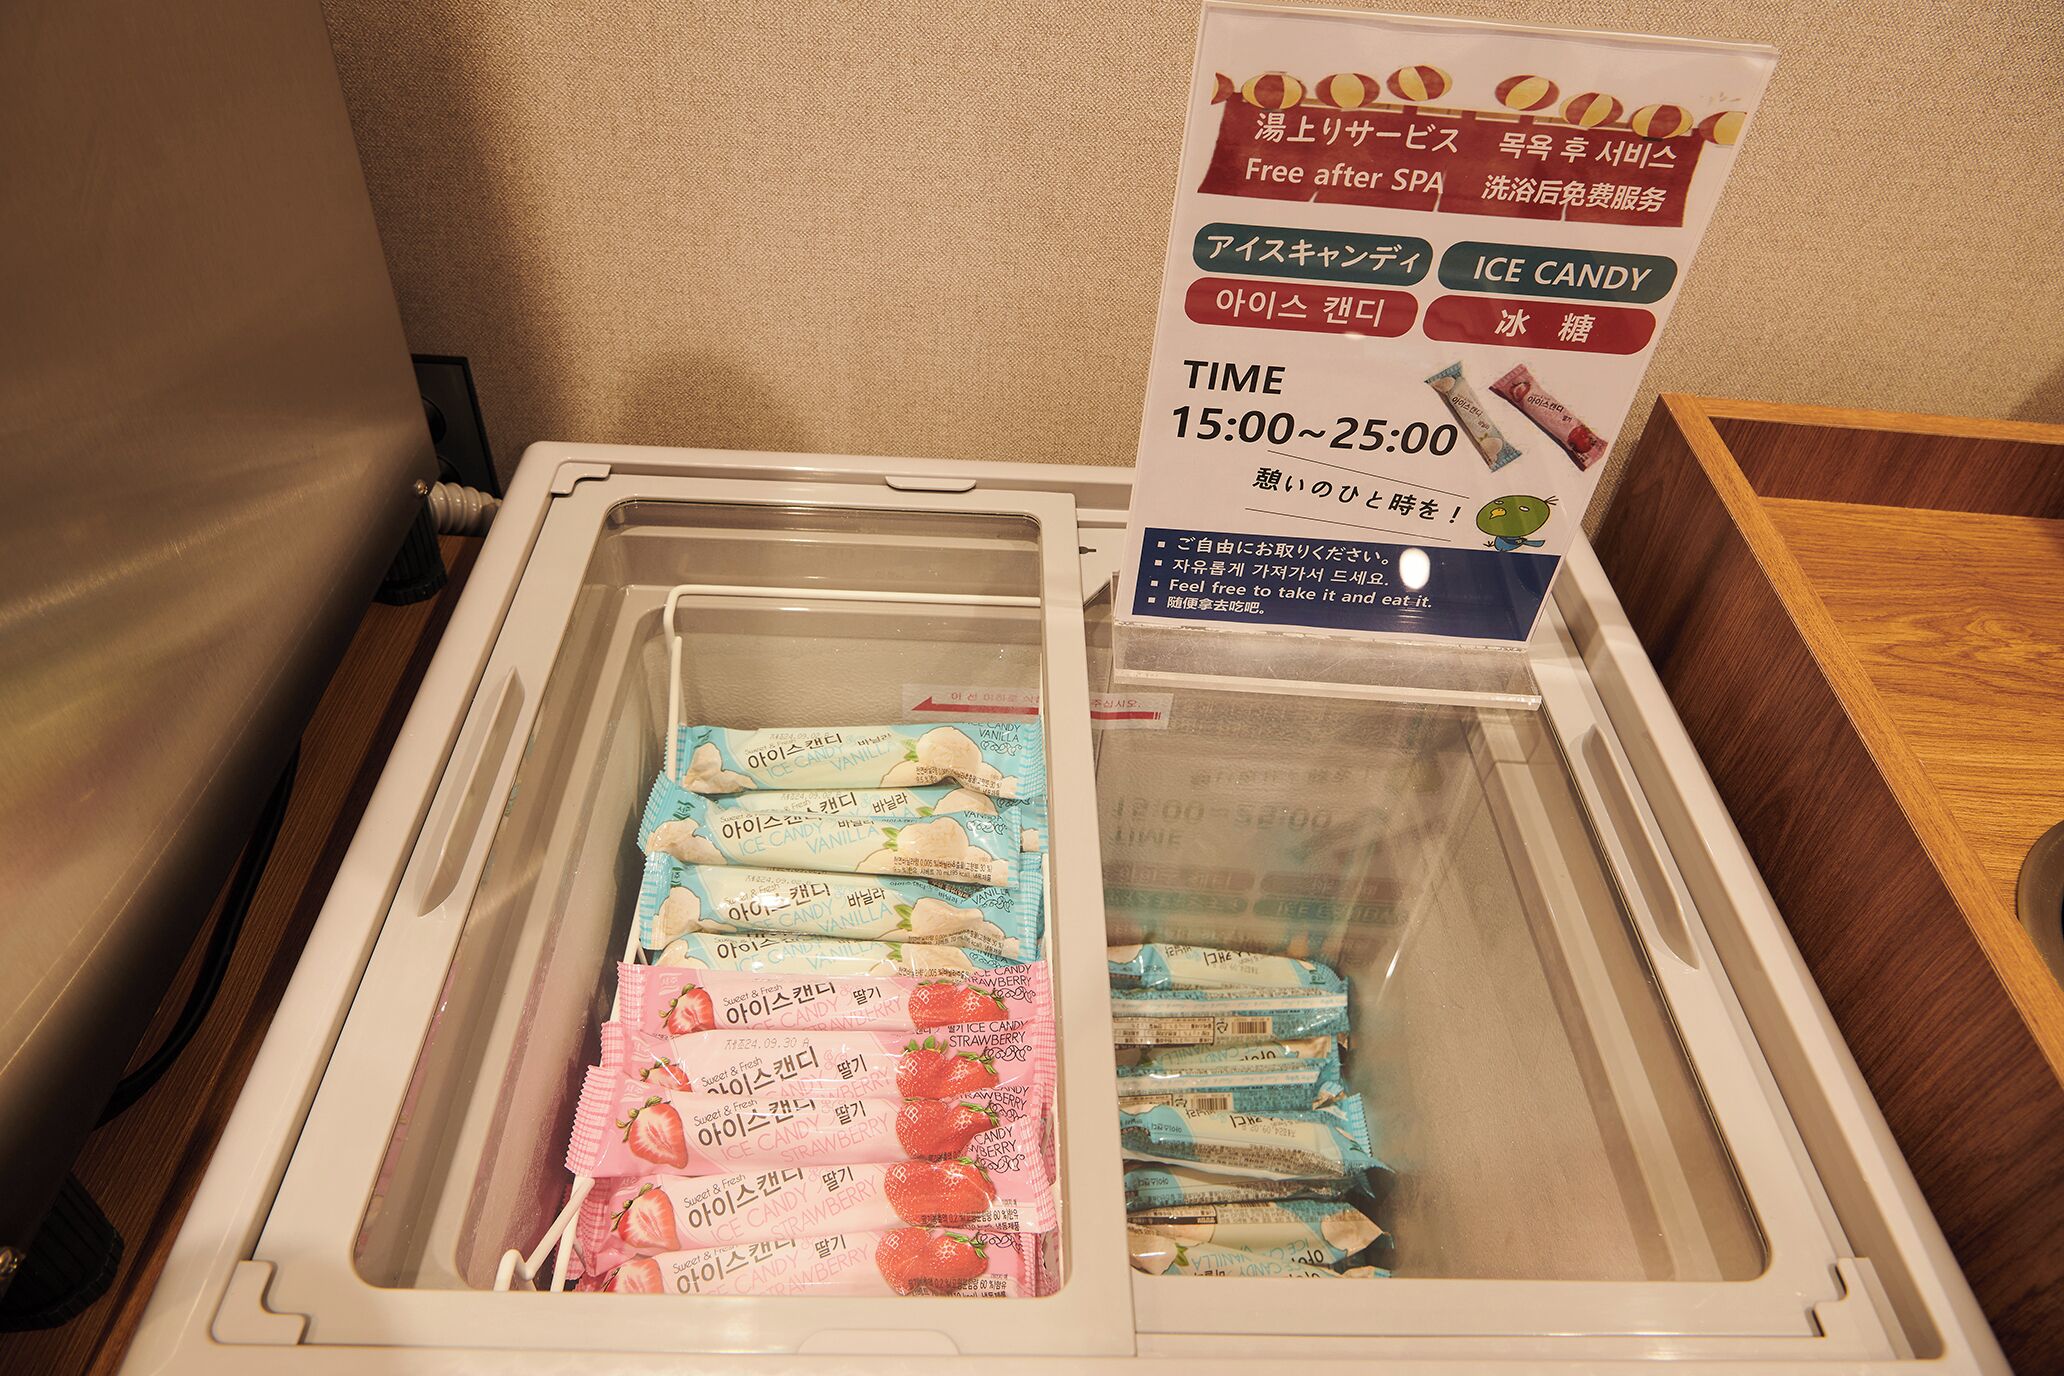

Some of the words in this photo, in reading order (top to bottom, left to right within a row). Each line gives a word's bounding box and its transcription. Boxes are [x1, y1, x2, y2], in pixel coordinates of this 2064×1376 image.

[1254, 112, 1459, 153] 湯上りサービス
[1499, 132, 1553, 161] 목욕
[1560, 137, 1589, 163] 후
[1595, 140, 1677, 169] 서비스
[1245, 157, 1305, 183] Free
[1313, 162, 1383, 189] after
[1391, 168, 1444, 194] SPA
[1481, 174, 1667, 212] 洗浴后免费服务
[1207, 235, 1420, 273] アイスキャンディ
[1473, 255, 1526, 282] ICE
[1534, 260, 1652, 291] CANDY
[1216, 288, 1308, 320] 아이스
[1323, 295, 1385, 328] 캔디
[1184, 359, 1286, 395] TIME
[1172, 405, 1458, 456] 15:00~25:00
[1178, 536, 1389, 566] ご自由にお取りください。
[1172, 558, 1245, 578] 자유롭게
[1252, 564, 1324, 583] 가져가서
[1331, 570, 1389, 586] 드세요.
[1167, 596, 1264, 615] 随便拿去吃吧。
[1169, 579, 1205, 593] Feel
[1212, 582, 1247, 596] free
[1254, 585, 1272, 597] to
[1279, 587, 1316, 600] take
[1323, 589, 1337, 602] it
[1341, 592, 1376, 604] and
[1382, 595, 1410, 607] eat
[1415, 595, 1432, 608] it.
[748, 733, 842, 769] 아이스캔디
[979, 728, 1020, 743] VANILLA
[873, 792, 908, 813] 바닐라
[847, 888, 885, 908] 바닐라
[723, 991, 750, 1006] Sweet
[752, 990, 759, 999] &
[761, 984, 783, 995] Fresh
[727, 982, 836, 1024] 아이스캔디
[853, 987, 881, 1006] 딸기
[949, 1031, 1026, 1048] STRAWBERRY
[966, 1023, 985, 1033] ICE
[989, 1020, 1029, 1032] CANDY
[701, 1071, 728, 1087] Sweet
[730, 1066, 739, 1076] &
[740, 1056, 763, 1072] Fresh
[837, 1054, 867, 1080] 딸기
[694, 1110, 721, 1127] Sweet
[723, 1105, 732, 1116] &
[733, 1098, 758, 1112] Fresh
[835, 1100, 866, 1126] 딸기
[722, 1140, 755, 1160] ICE
[758, 1114, 819, 1151] CANDY
[780, 1113, 889, 1163] STRAWBERRY
[974, 1126, 1013, 1145] CANDY
[684, 1189, 711, 1208] Sweet
[712, 1184, 721, 1195] &
[722, 1174, 746, 1189] Fresh
[689, 1168, 803, 1228] 아이스캔디
[822, 1166, 854, 1192] 딸기
[711, 1217, 744, 1243] ICE
[747, 1182, 808, 1228] CANDY
[770, 1175, 878, 1240] STRAWBERRY
[673, 1255, 701, 1274] Sweet
[703, 1250, 712, 1260] &
[815, 1234, 846, 1258] 딸기
